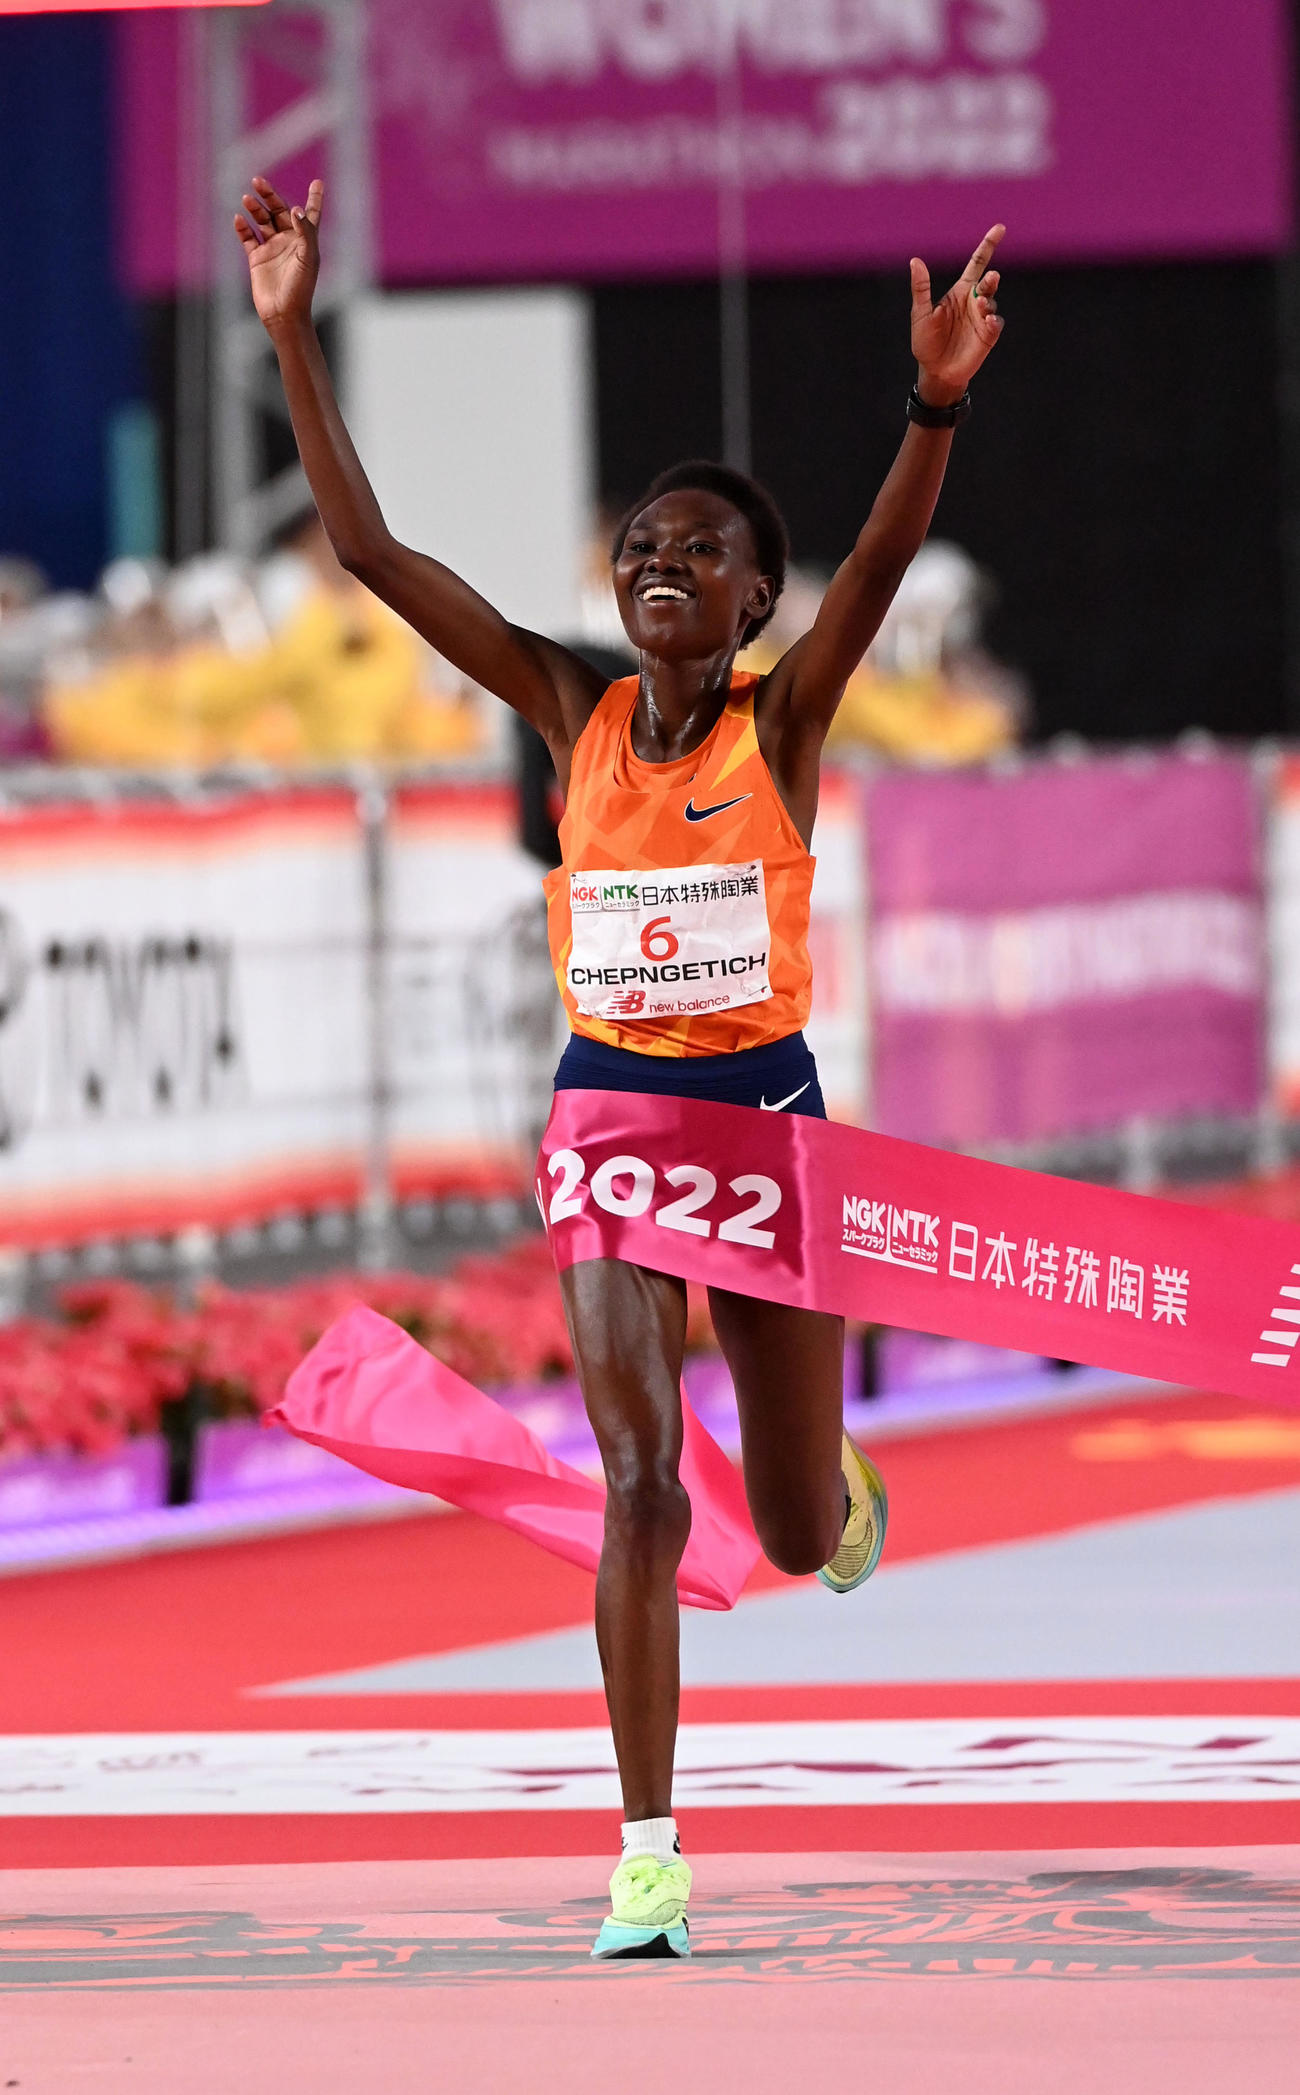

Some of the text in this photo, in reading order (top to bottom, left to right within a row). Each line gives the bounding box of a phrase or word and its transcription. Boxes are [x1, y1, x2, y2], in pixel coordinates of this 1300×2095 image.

[571, 875, 759, 906] NGK NTK 日本特殊陶業
[640, 916, 679, 962] 6
[571, 952, 767, 985] CHEPNGETICH
[649, 1002, 675, 1014] new
[677, 994, 731, 1012] balance
[547, 1149, 782, 1250] 2022
[842, 1193, 1190, 1326] NGK NTK 日本特殊陶業
